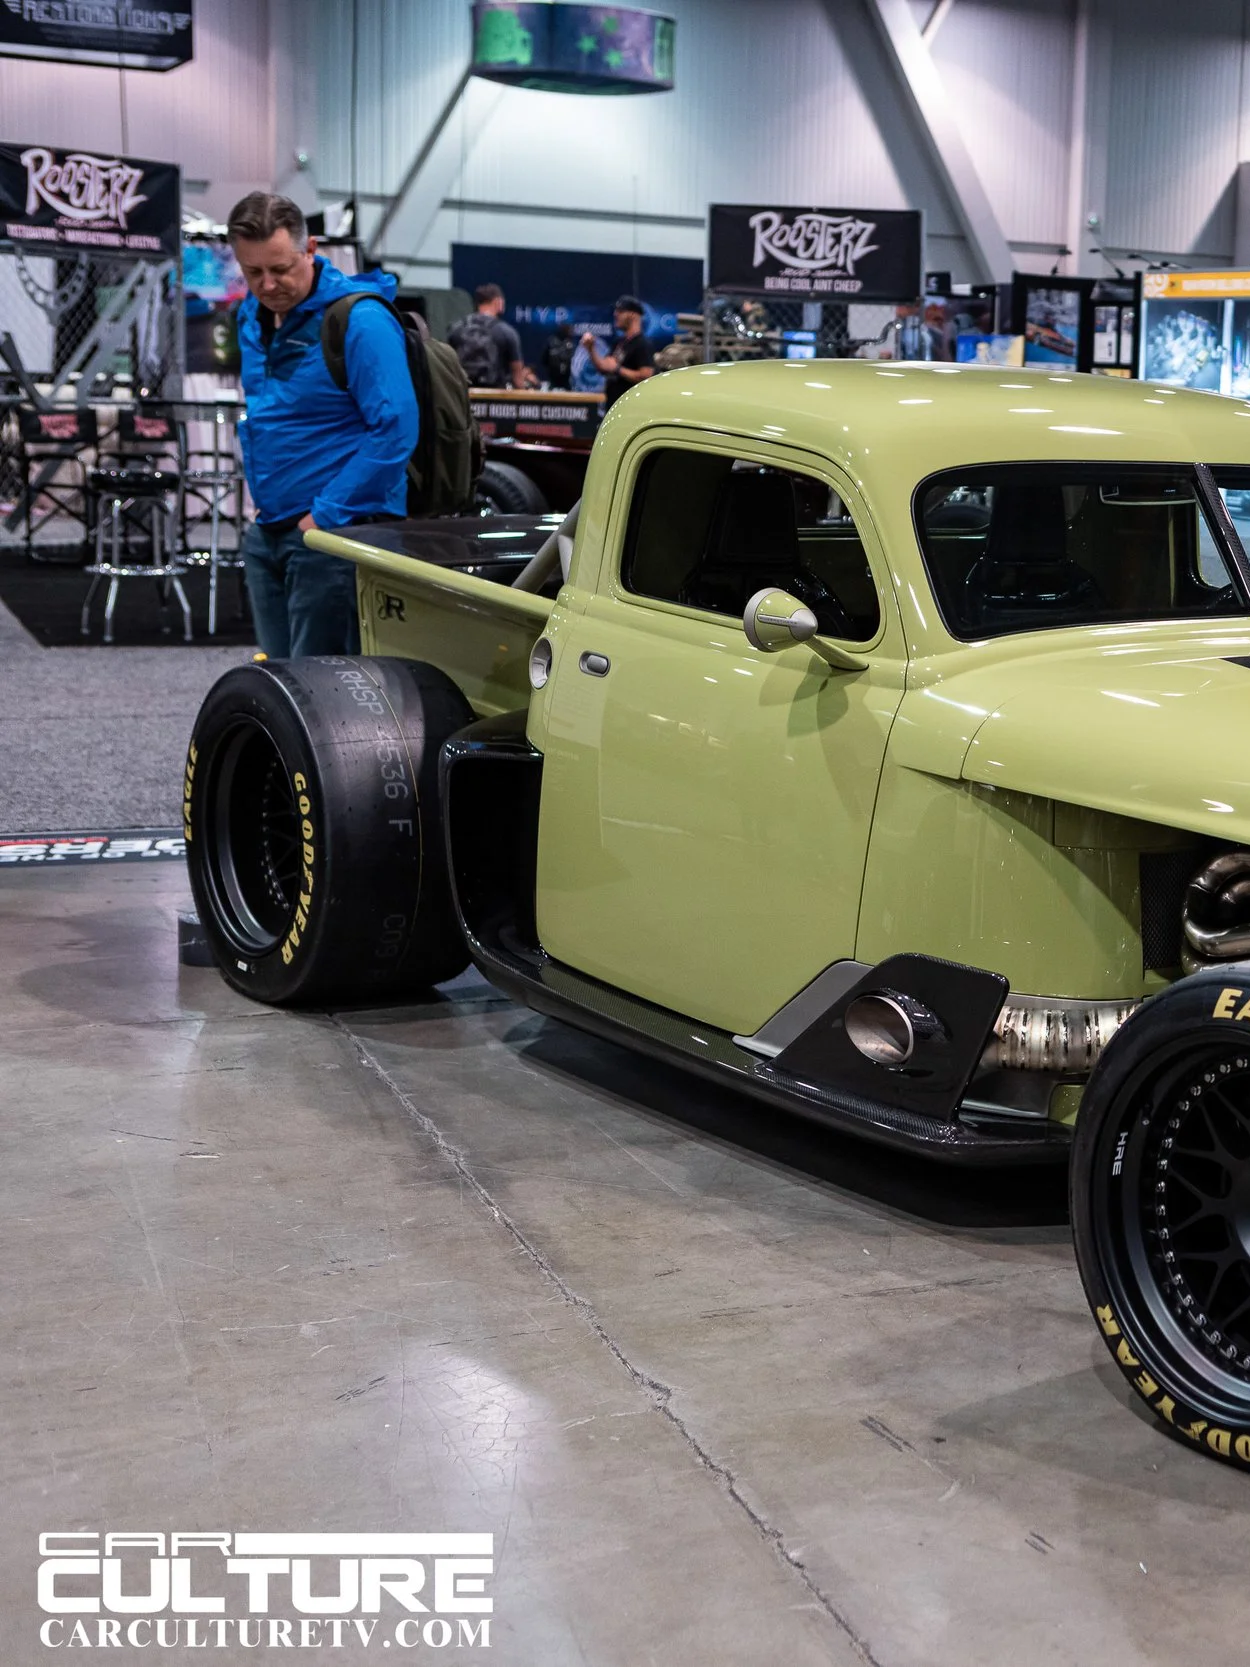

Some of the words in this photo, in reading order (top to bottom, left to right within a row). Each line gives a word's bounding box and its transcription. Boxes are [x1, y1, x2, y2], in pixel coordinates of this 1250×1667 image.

[335, 670, 384, 715] RHSP
[183, 740, 198, 842] EAGLE
[281, 770, 315, 966] GOODYEAR
[1112, 1131, 1128, 1176] HRE
